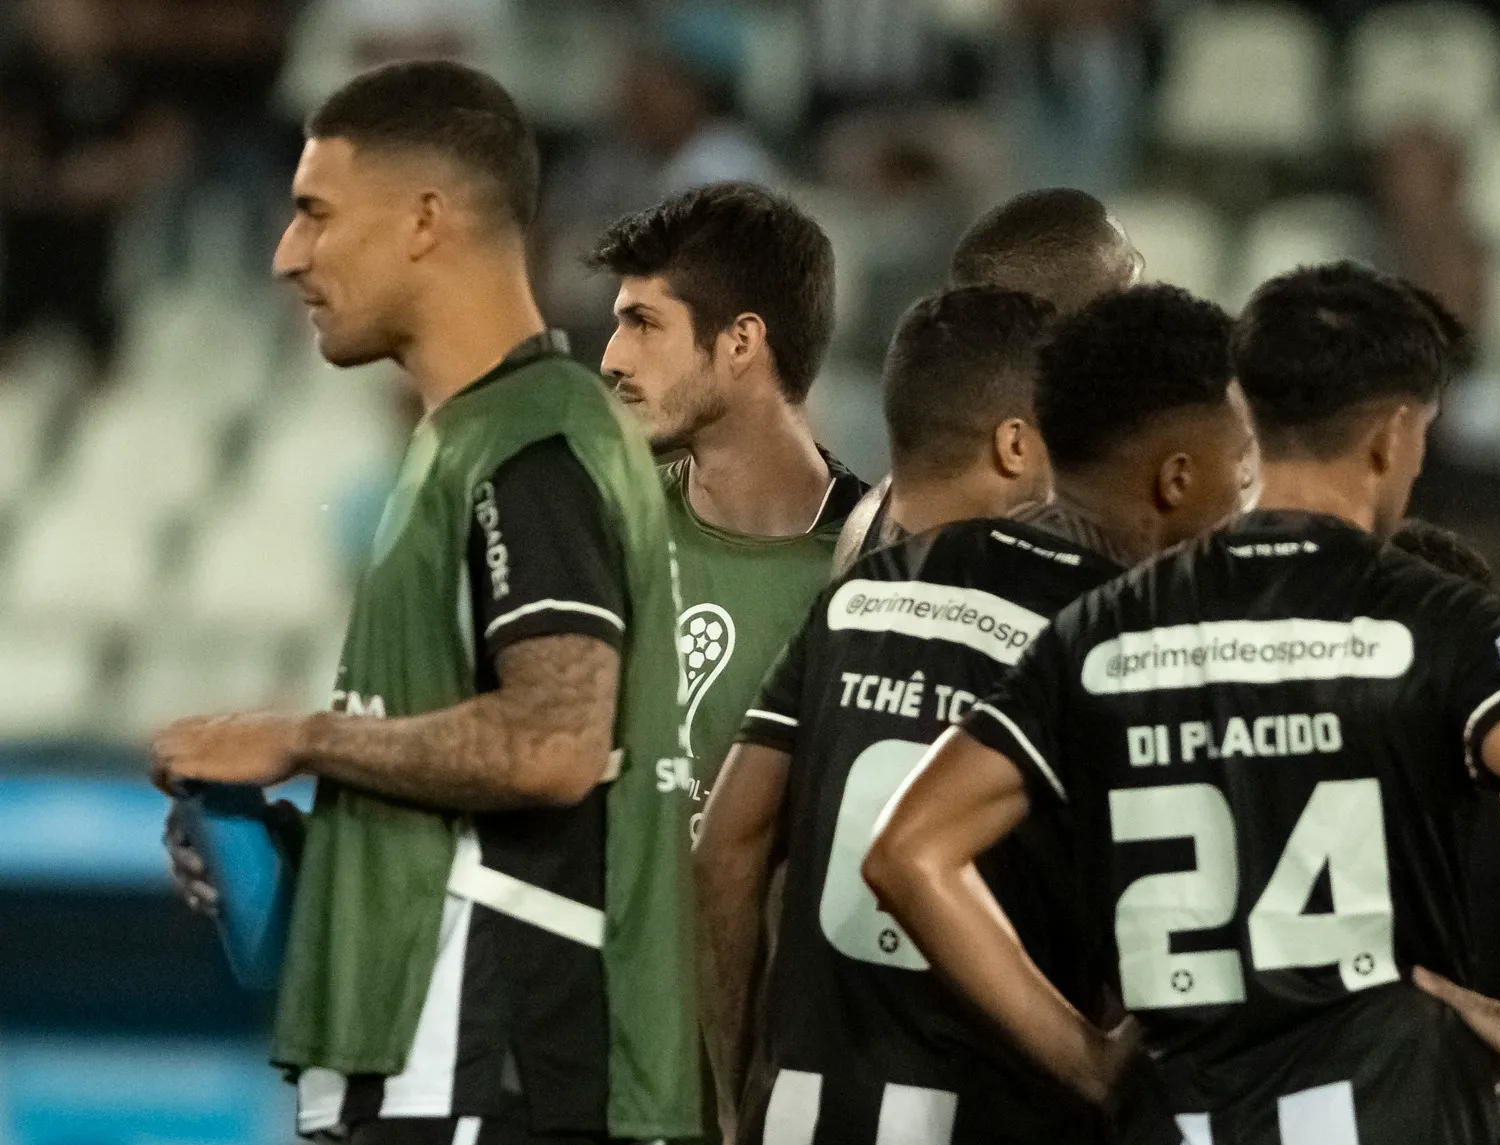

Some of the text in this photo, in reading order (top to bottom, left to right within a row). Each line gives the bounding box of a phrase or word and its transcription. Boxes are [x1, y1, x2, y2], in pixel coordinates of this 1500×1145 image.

[840, 669, 925, 718] TCHÊ
[1127, 712, 1343, 767] DI PLACIDO
[1108, 777, 1400, 1011] 24
